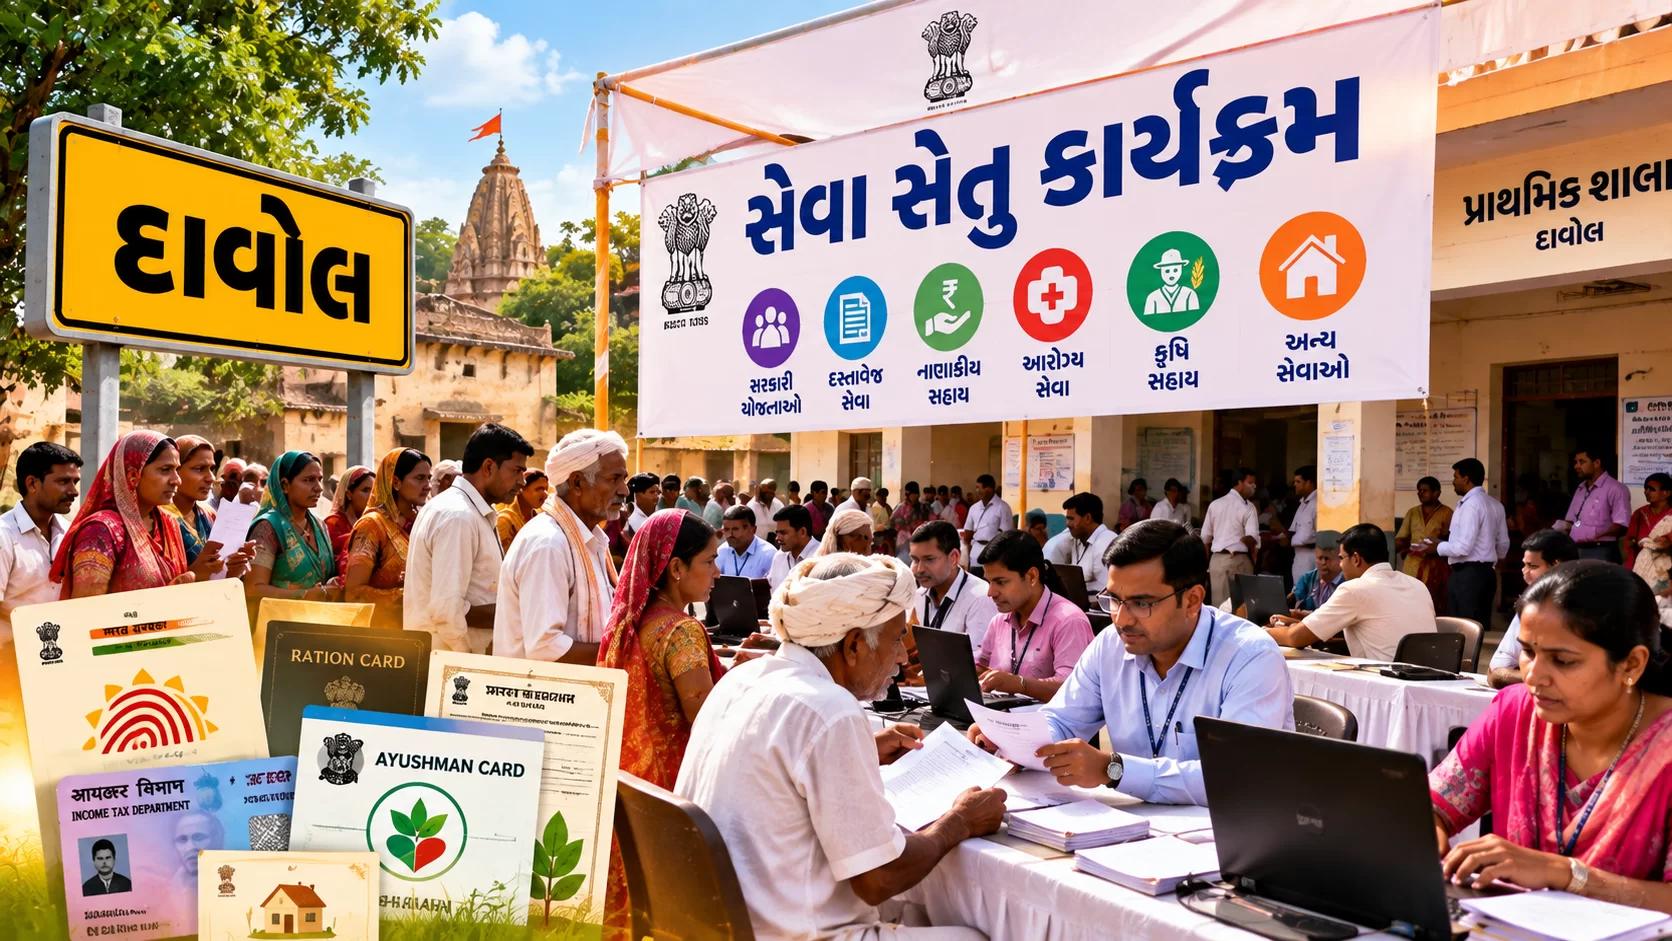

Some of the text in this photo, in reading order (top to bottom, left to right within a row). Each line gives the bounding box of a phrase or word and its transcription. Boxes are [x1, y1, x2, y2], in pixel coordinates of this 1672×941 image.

[745, 68, 1360, 256] સેવા સેતુ કાર્યક્રમ
[1462, 158, 1672, 226] પ્રાથમિક શાલા
[1535, 216, 1604, 251] દાવોલ
[114, 193, 371, 324] દાવોલ
[1285, 330, 1336, 351] અન્ય
[916, 354, 981, 380] નાણાકીય
[1022, 347, 1084, 371] આરોગ્ય
[1276, 352, 1349, 383] સેવાઓ
[749, 370, 793, 393] સરકારી
[828, 363, 884, 387] દસ્તાવેજ
[1035, 375, 1070, 398] સેવા
[1147, 369, 1199, 391] સહાય
[841, 389, 870, 411] સેવા
[928, 386, 970, 406] સહાય
[290, 648, 406, 670] RATION CARD
[374, 751, 526, 778] AYUSHMAN CARD
[71, 800, 191, 822] INCOME TAX DEPARTMENT
